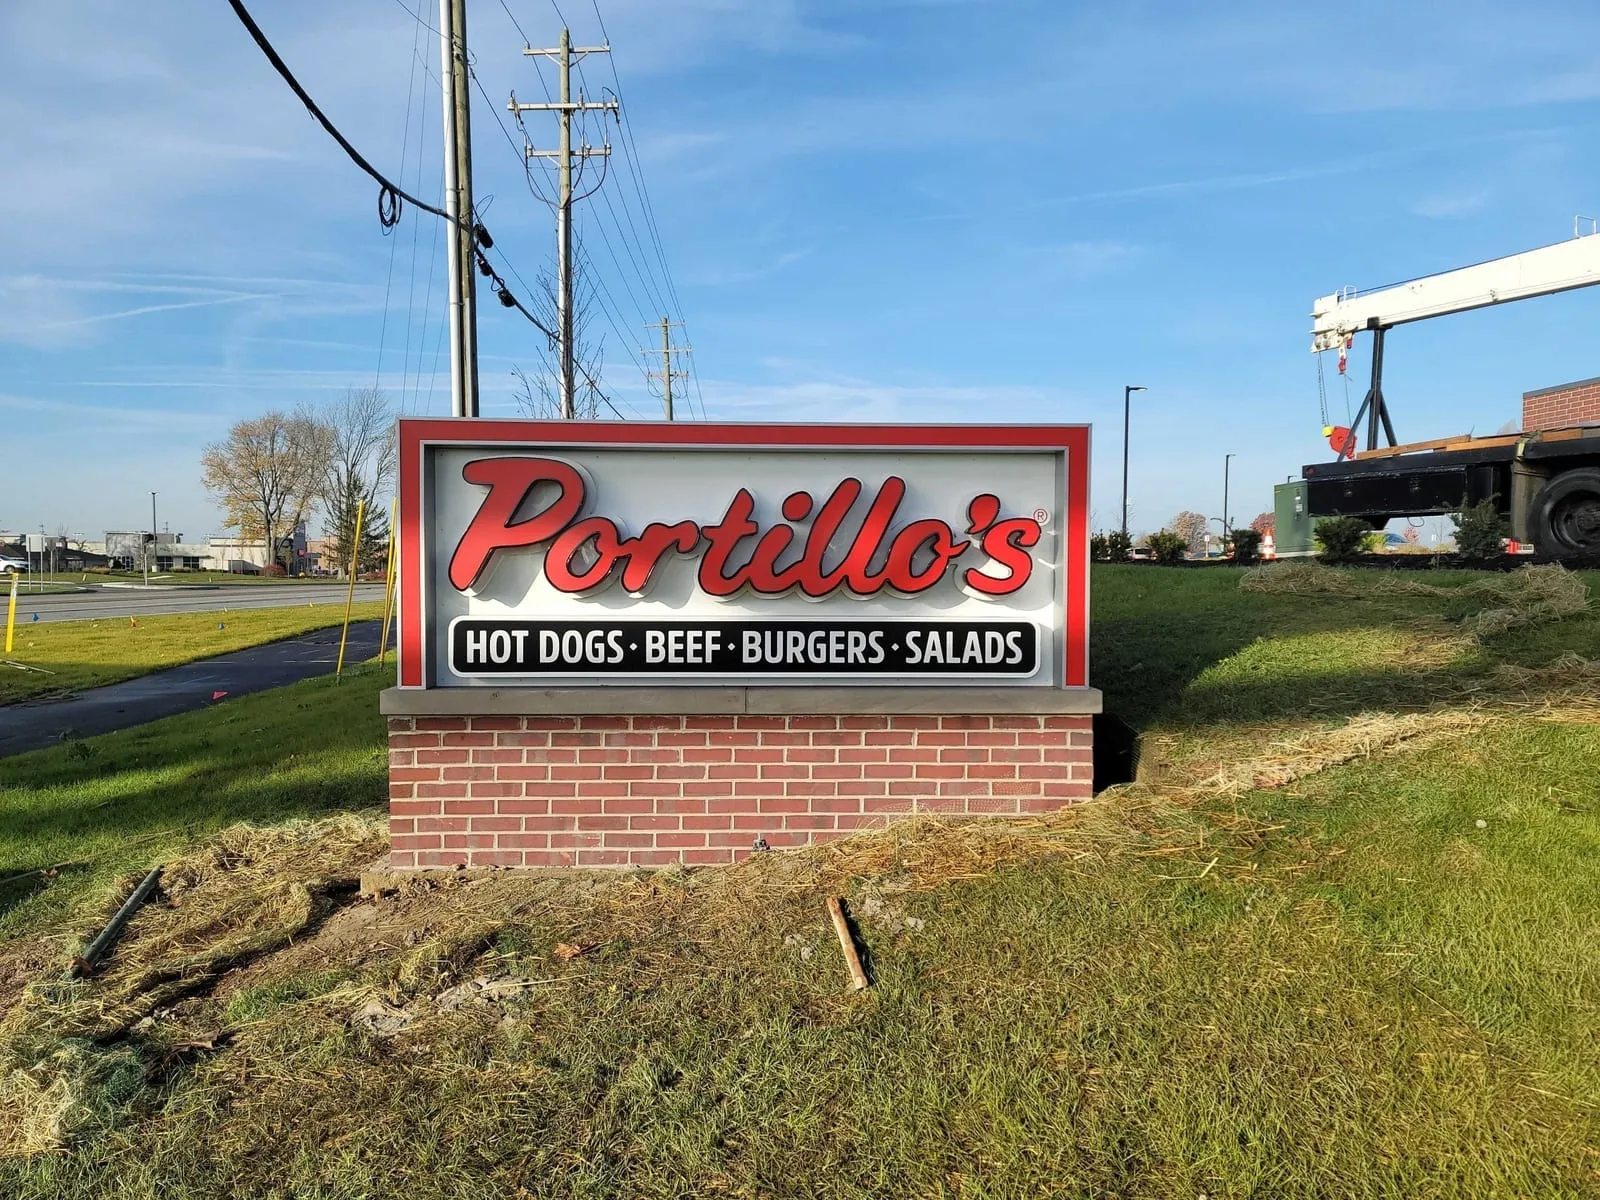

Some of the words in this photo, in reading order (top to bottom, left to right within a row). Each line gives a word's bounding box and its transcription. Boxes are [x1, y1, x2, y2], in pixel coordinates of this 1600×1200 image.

[466, 629, 529, 664] HOT
[539, 629, 624, 664] DOGS
[645, 630, 721, 664] BEEF
[742, 630, 885, 664] BURGERS
[905, 630, 1023, 664] SALADS
